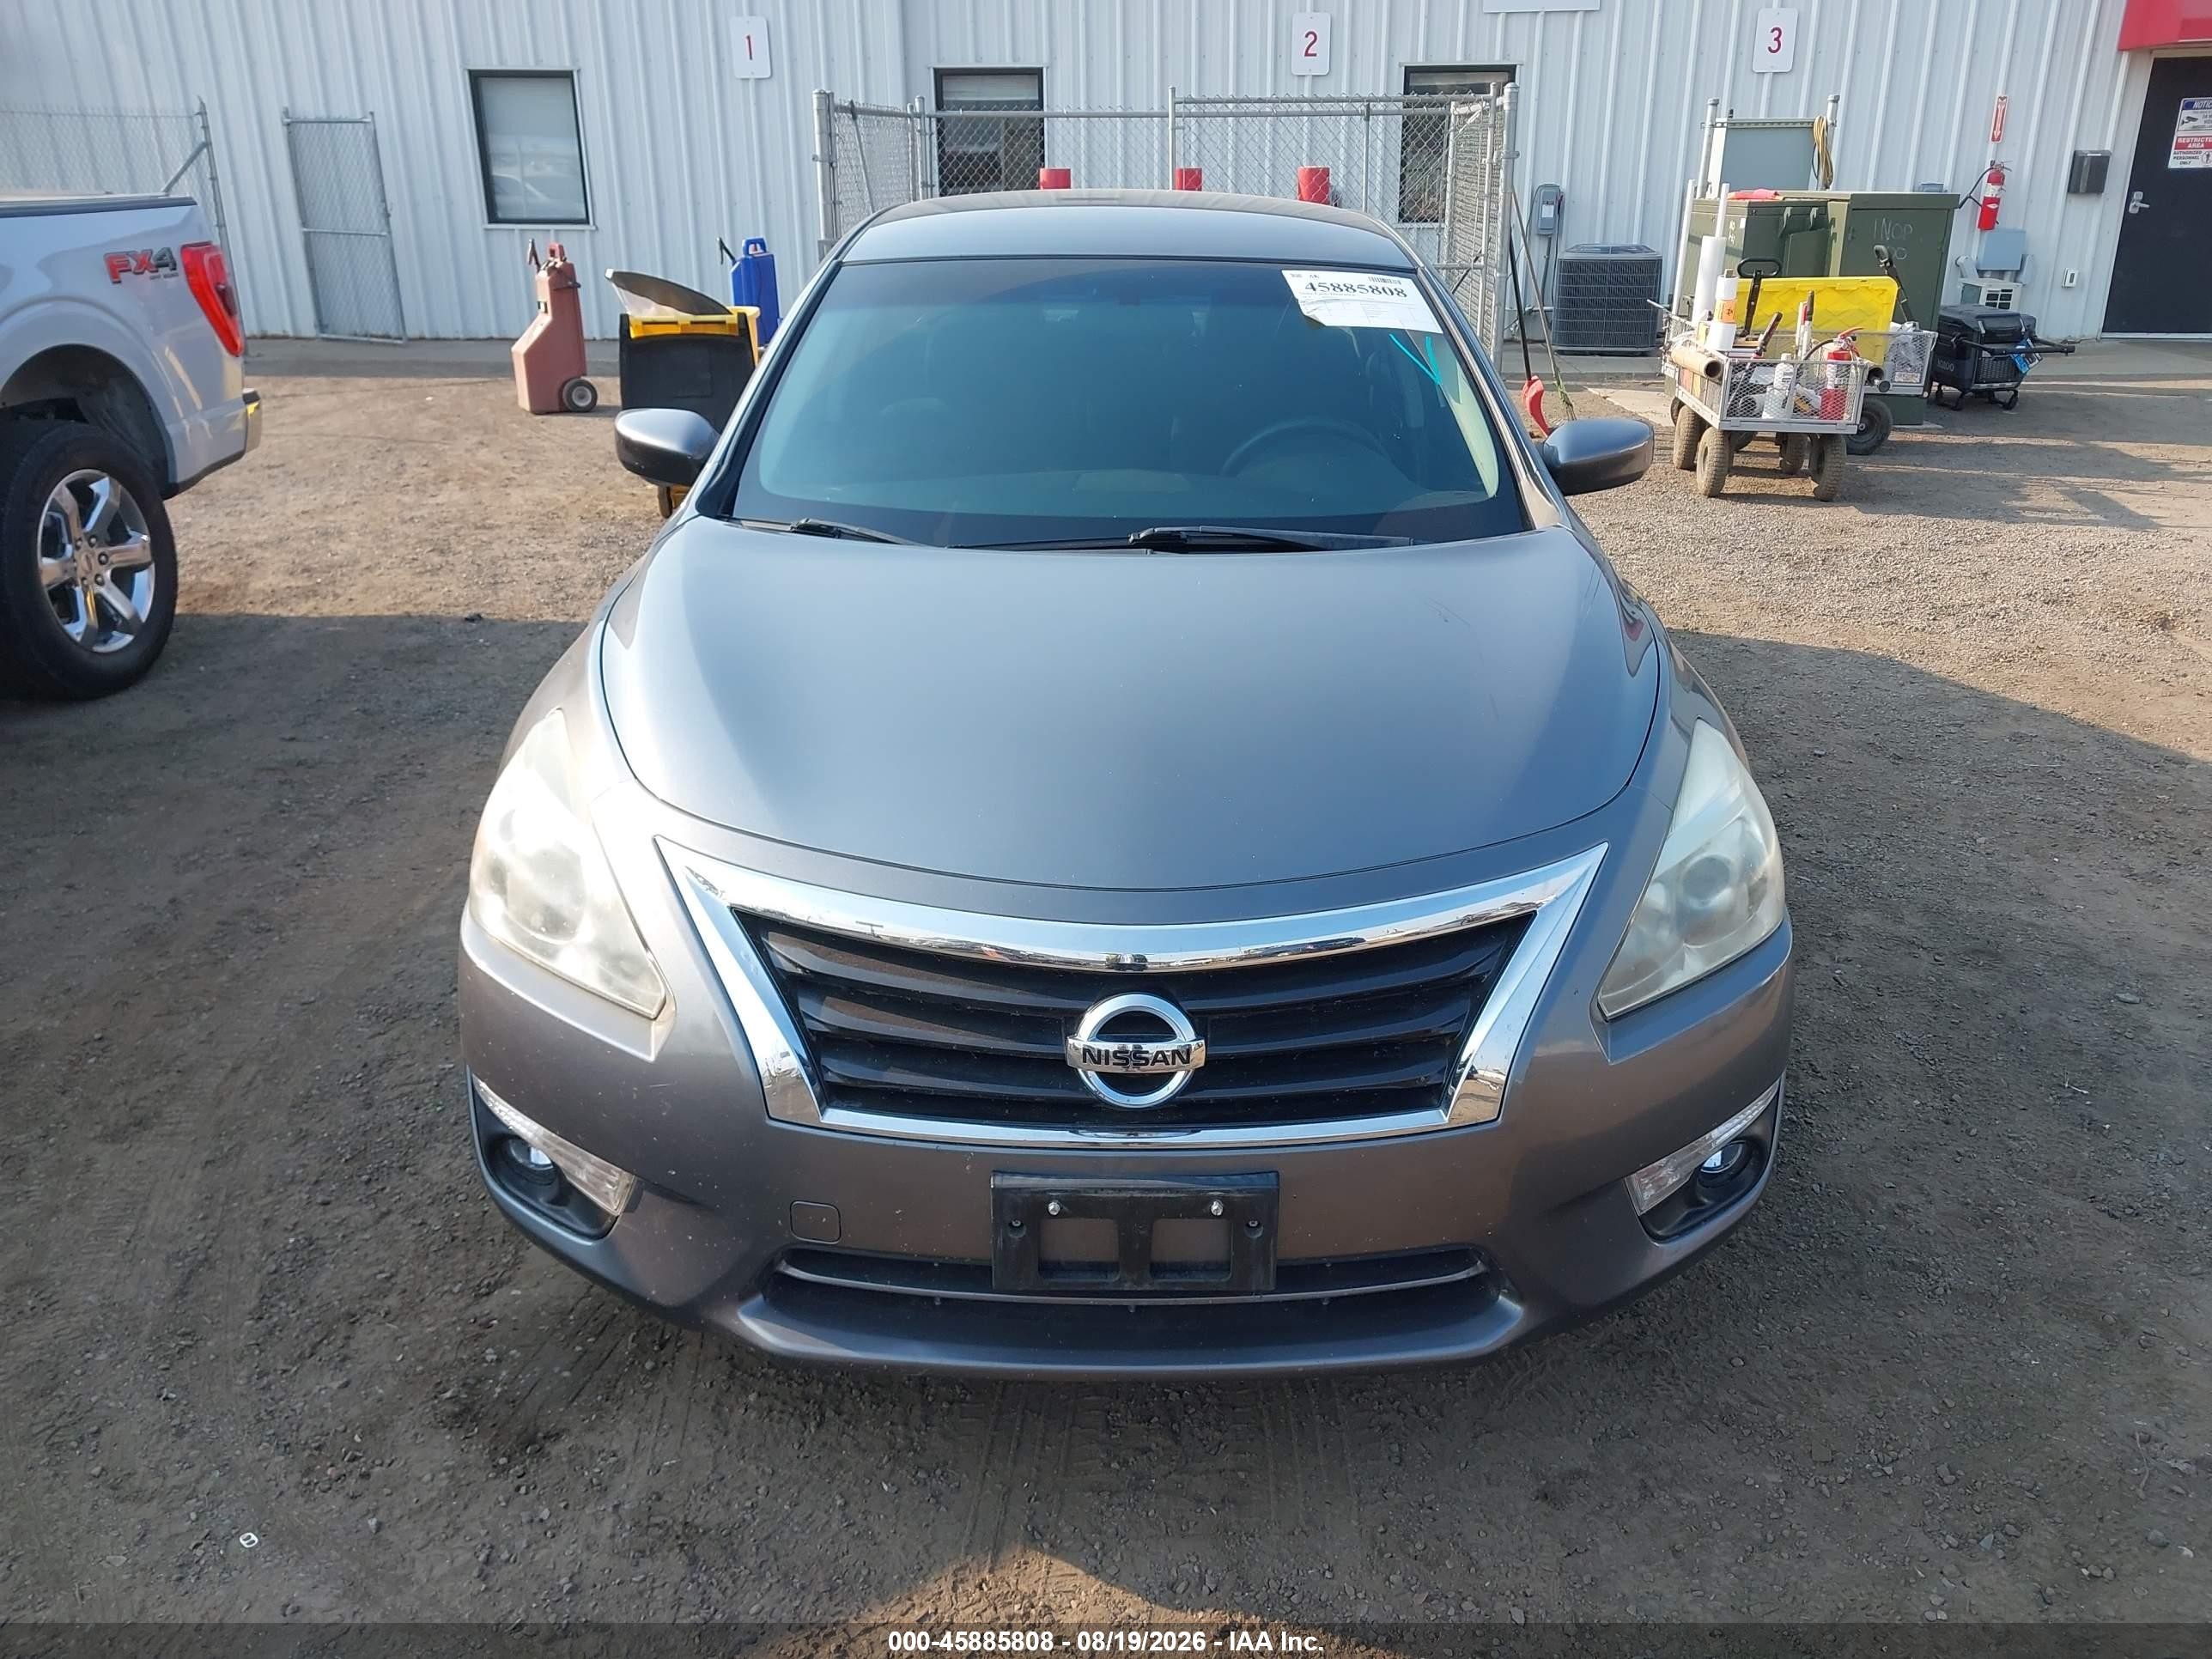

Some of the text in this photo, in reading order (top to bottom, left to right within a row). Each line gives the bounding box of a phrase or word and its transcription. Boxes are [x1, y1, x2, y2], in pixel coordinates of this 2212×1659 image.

[745, 34, 753, 61] 1
[1304, 30, 1318, 58] 2
[1767, 27, 1783, 54] 3
[104, 247, 178, 283] FX4
[1304, 282, 1407, 298] 45885808
[1082, 1045, 1191, 1066] NISSAN
